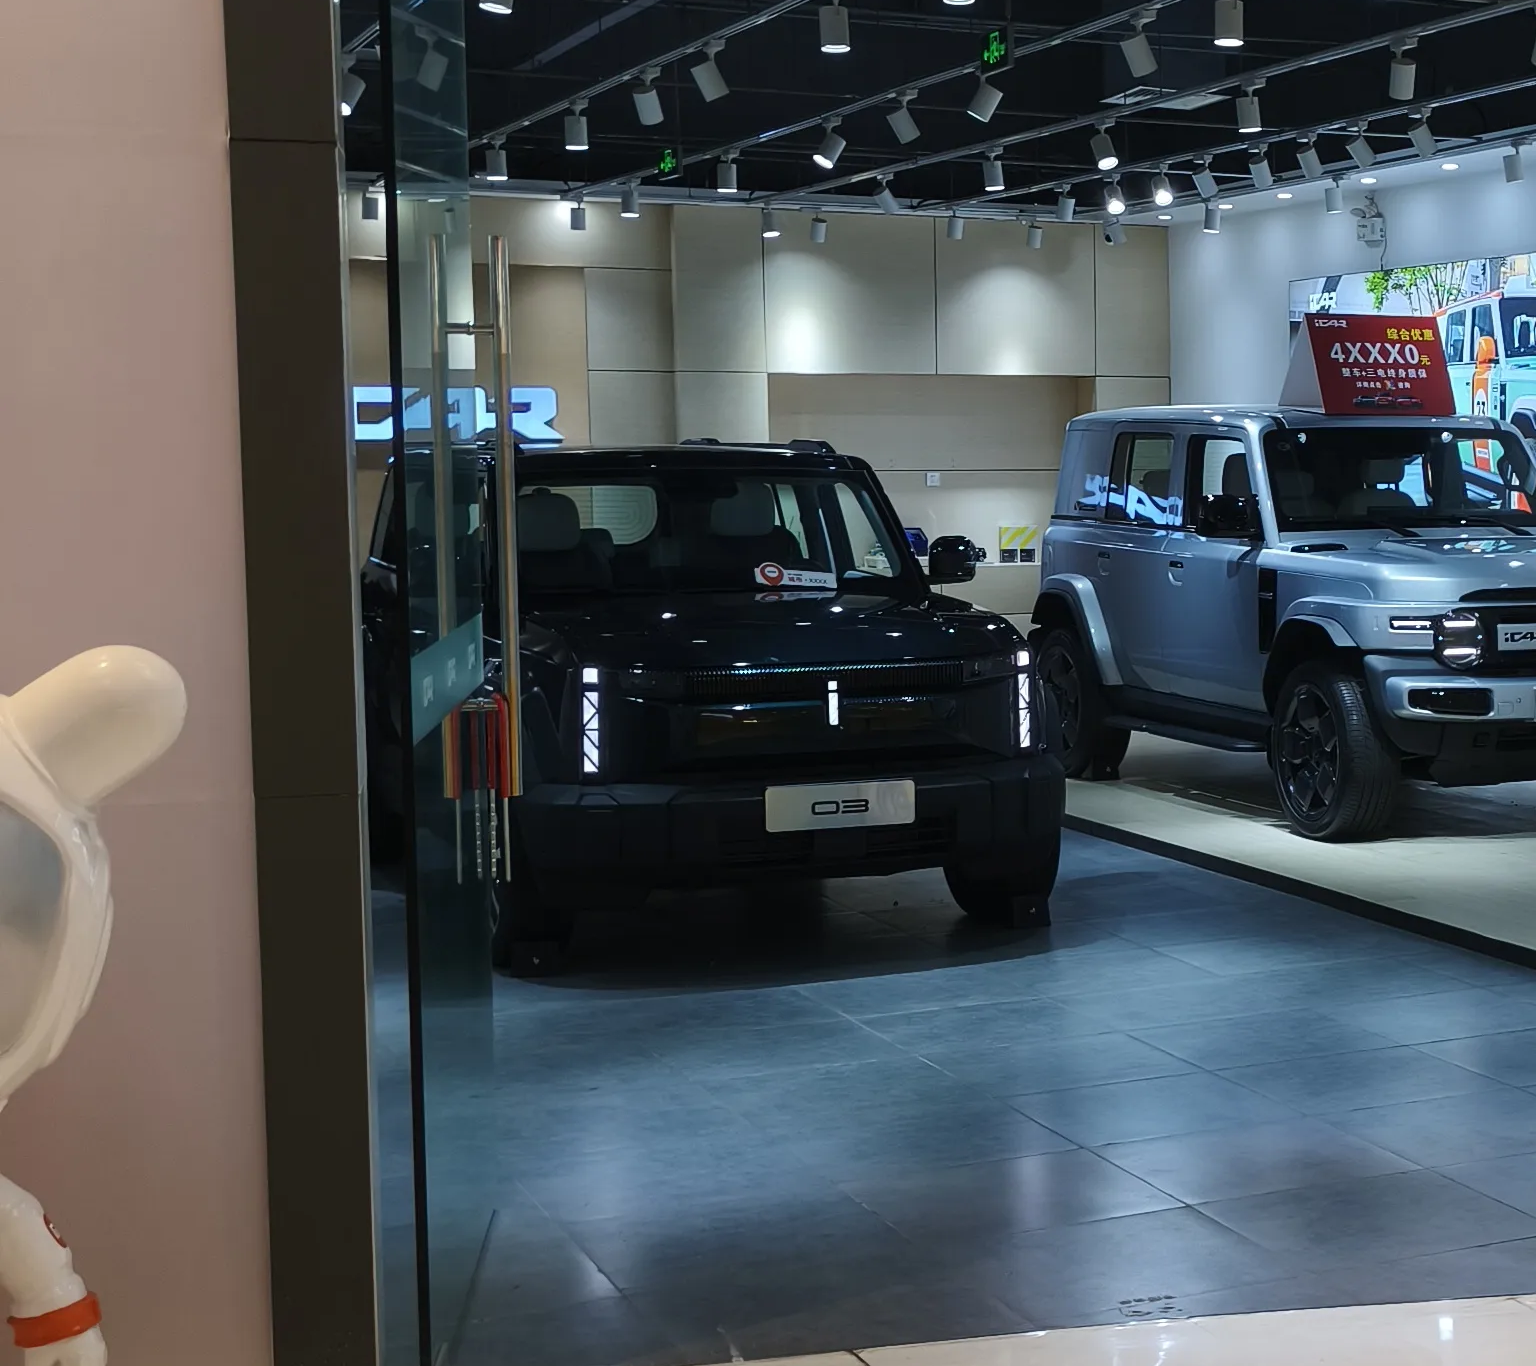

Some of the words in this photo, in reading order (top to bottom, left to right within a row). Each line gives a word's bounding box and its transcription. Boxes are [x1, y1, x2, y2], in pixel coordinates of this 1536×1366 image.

[1386, 328, 1435, 341] 综合优惠
[353, 386, 566, 440] CAR
[811, 798, 870, 816] 03
